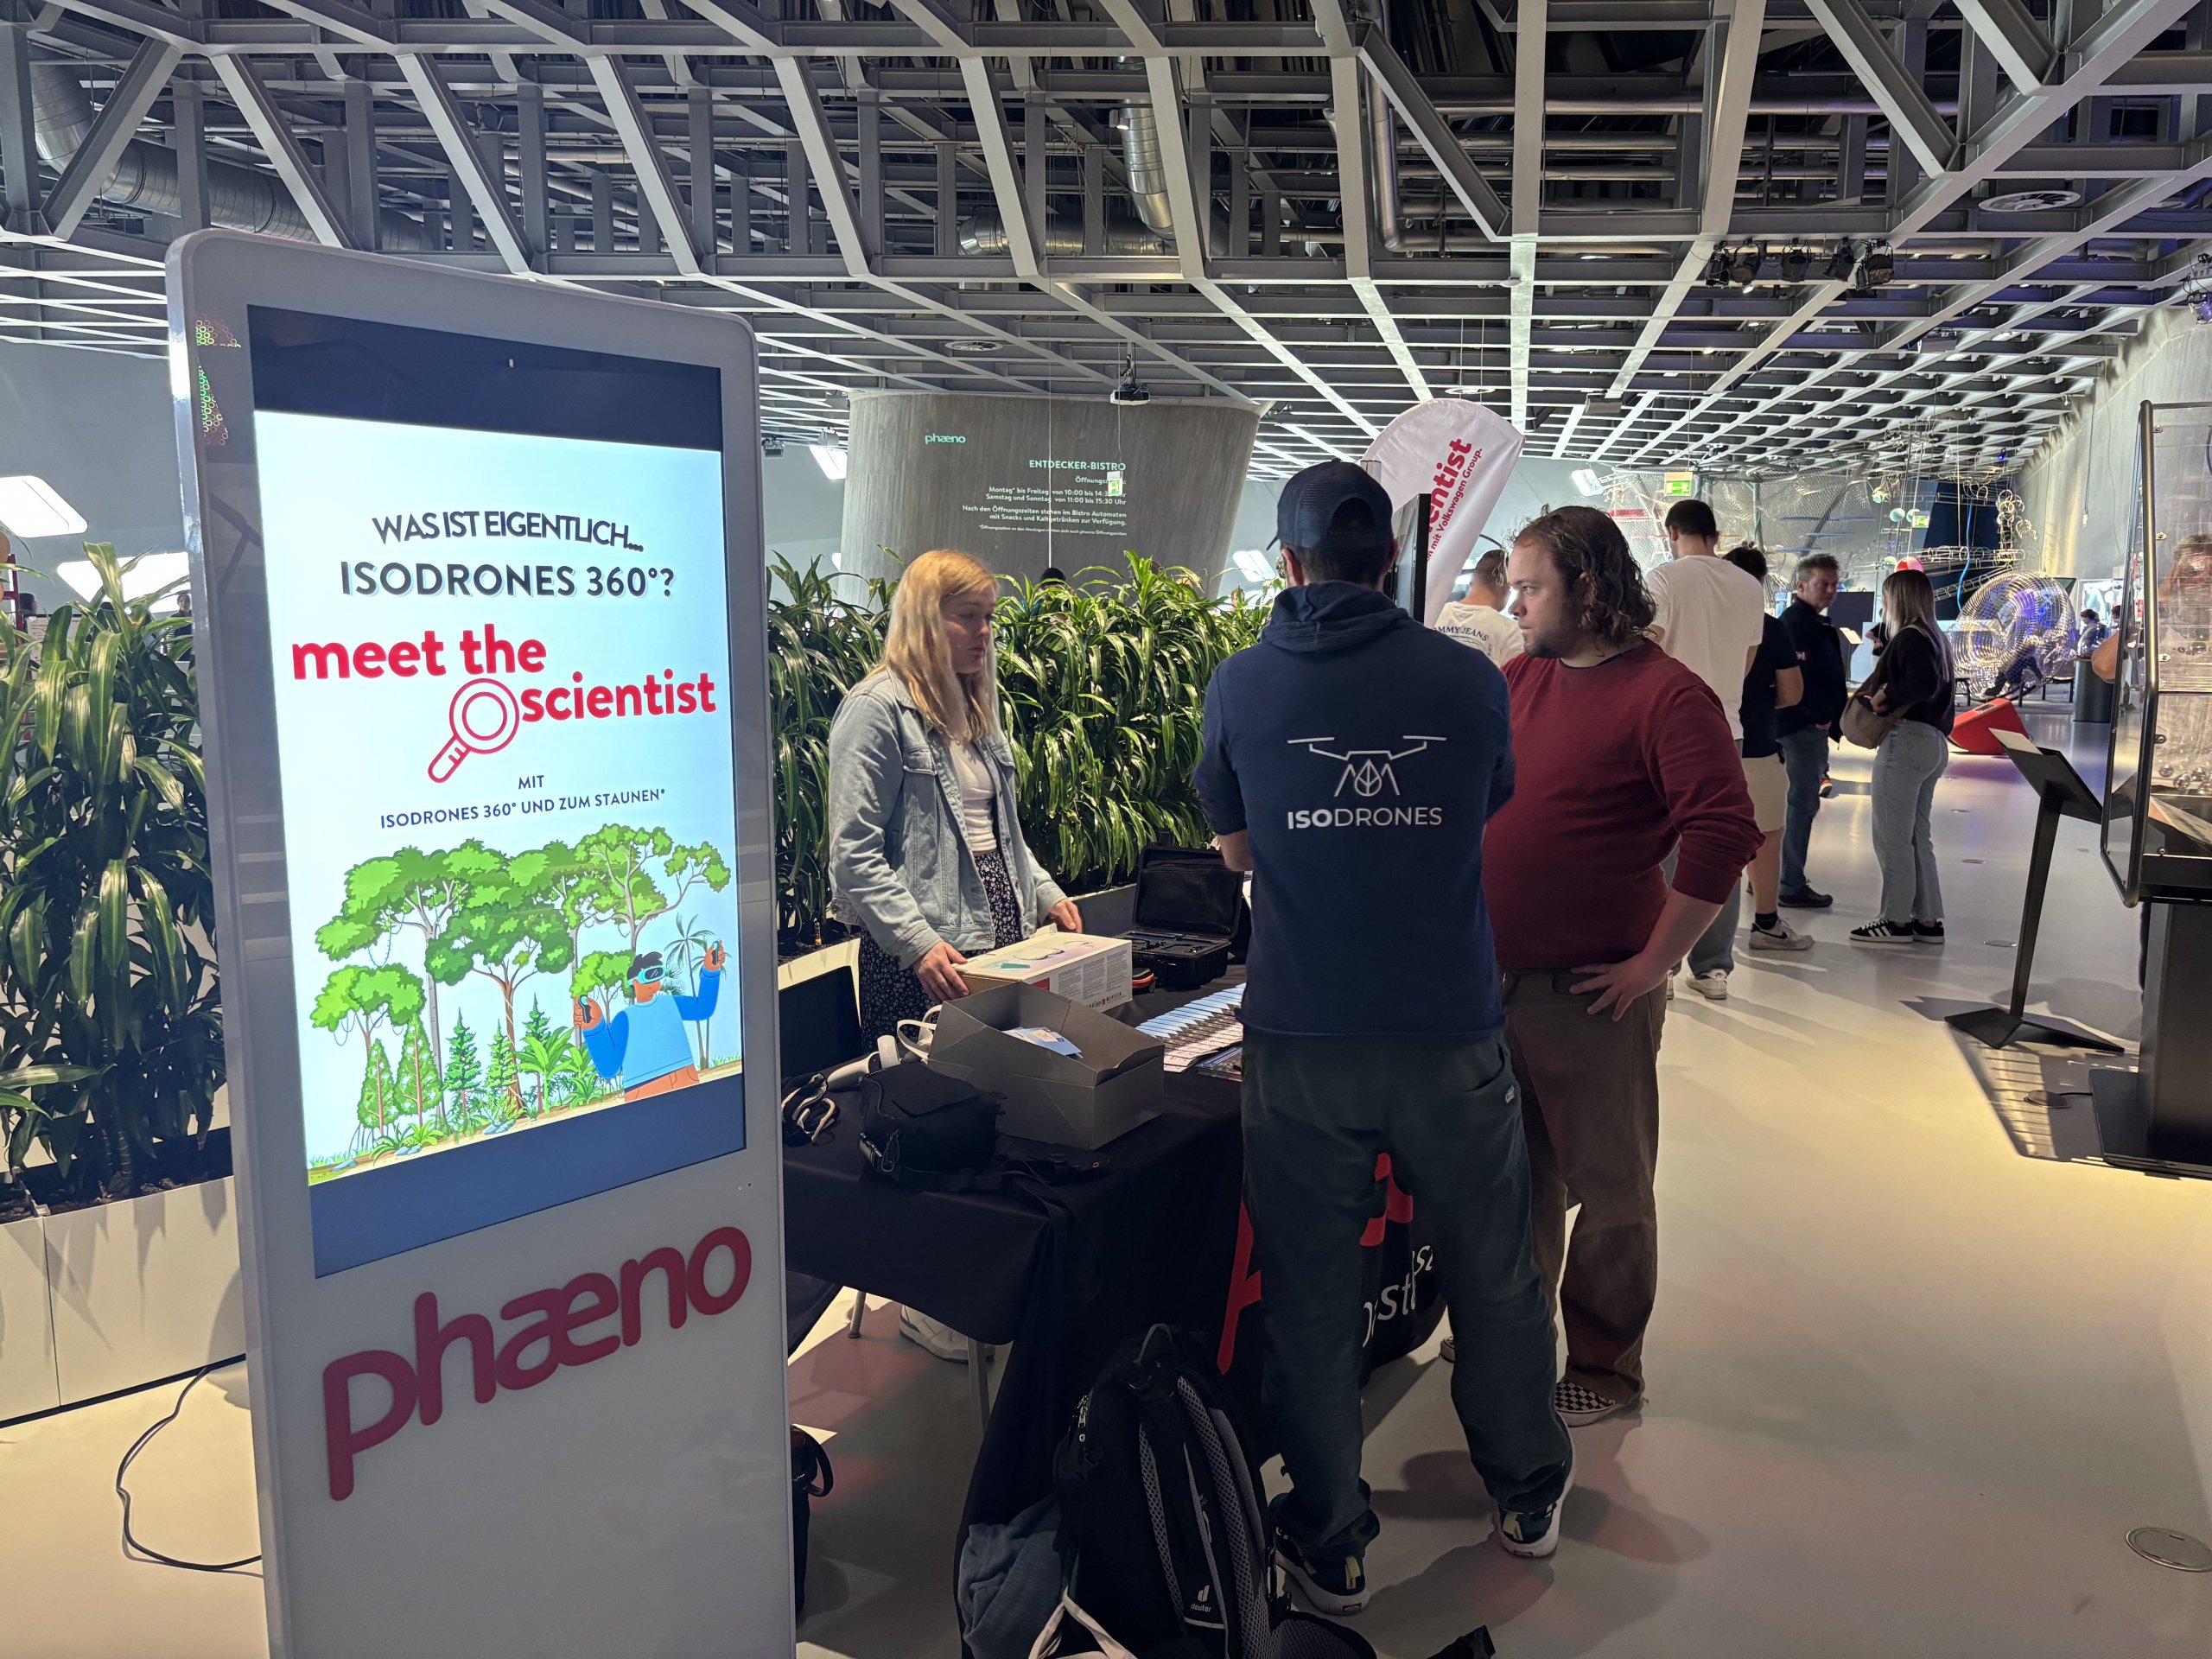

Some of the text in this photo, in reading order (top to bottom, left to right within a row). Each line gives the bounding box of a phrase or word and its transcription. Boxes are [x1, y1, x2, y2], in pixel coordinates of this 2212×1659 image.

[1028, 460, 1127, 471] ENTDECKER-BISTRO
[1428, 438, 1472, 533] entist
[1431, 533, 1442, 550] mit
[1437, 480, 1467, 531] Volkswagen
[1462, 448, 1483, 479] Group.
[992, 505, 1039, 514] Öffnungszeiten
[372, 510, 645, 553] WAS IST EIGENTLICH...
[340, 561, 676, 599] ISODRONES 360°?
[292, 623, 547, 680] meet the
[1434, 626, 1489, 641] MMY JEANS
[520, 668, 717, 722] scientist
[518, 774, 545, 790] MIT
[380, 804, 479, 829] ISODRONES
[483, 801, 518, 819] 360°
[520, 798, 555, 815] UND
[558, 793, 592, 810] ZUM
[1287, 806, 1443, 830] ISODRONES
[1191, 1603, 1212, 1612] deuter
